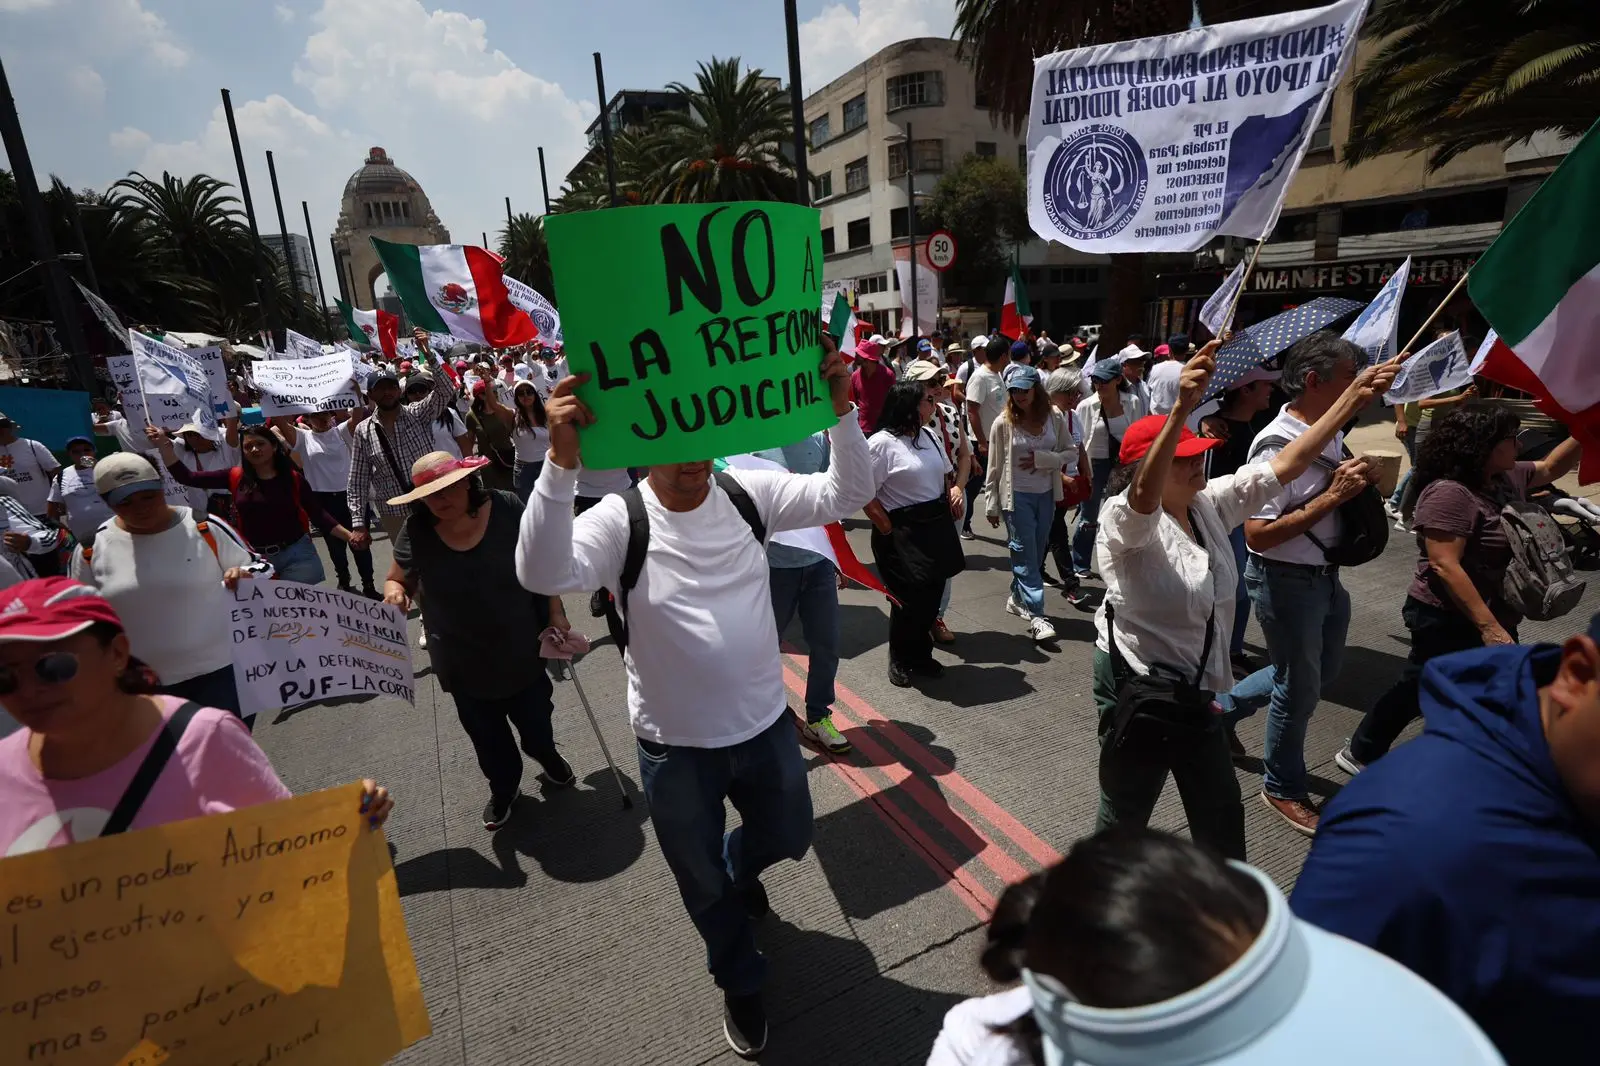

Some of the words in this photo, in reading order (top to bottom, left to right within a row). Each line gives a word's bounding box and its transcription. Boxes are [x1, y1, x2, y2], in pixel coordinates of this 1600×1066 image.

[660, 205, 776, 316] NO
[802, 236, 817, 293] A
[934, 240, 949, 253] 50
[589, 328, 671, 391] LA
[271, 394, 317, 405] MACHISMO
[315, 398, 356, 411] POLÍTICO
[631, 369, 823, 440] JUDICIAL
[230, 608, 253, 622] ES
[263, 606, 328, 620] NUESTRA
[234, 586, 264, 602] LA
[274, 586, 396, 624] CONSTITUCIÓN
[233, 626, 257, 644] DE
[246, 660, 277, 683] HOY
[285, 658, 306, 673] LA
[319, 654, 404, 681] DEFENDEMOS
[6, 893, 43, 915] es
[60, 876, 102, 904] un
[116, 849, 200, 899] poder
[220, 823, 347, 868] Autonomo
[236, 888, 275, 920] ya
[302, 868, 335, 891] no
[28, 1024, 108, 1062] mas
[140, 977, 250, 1039] poder
[219, 990, 279, 1027] van
